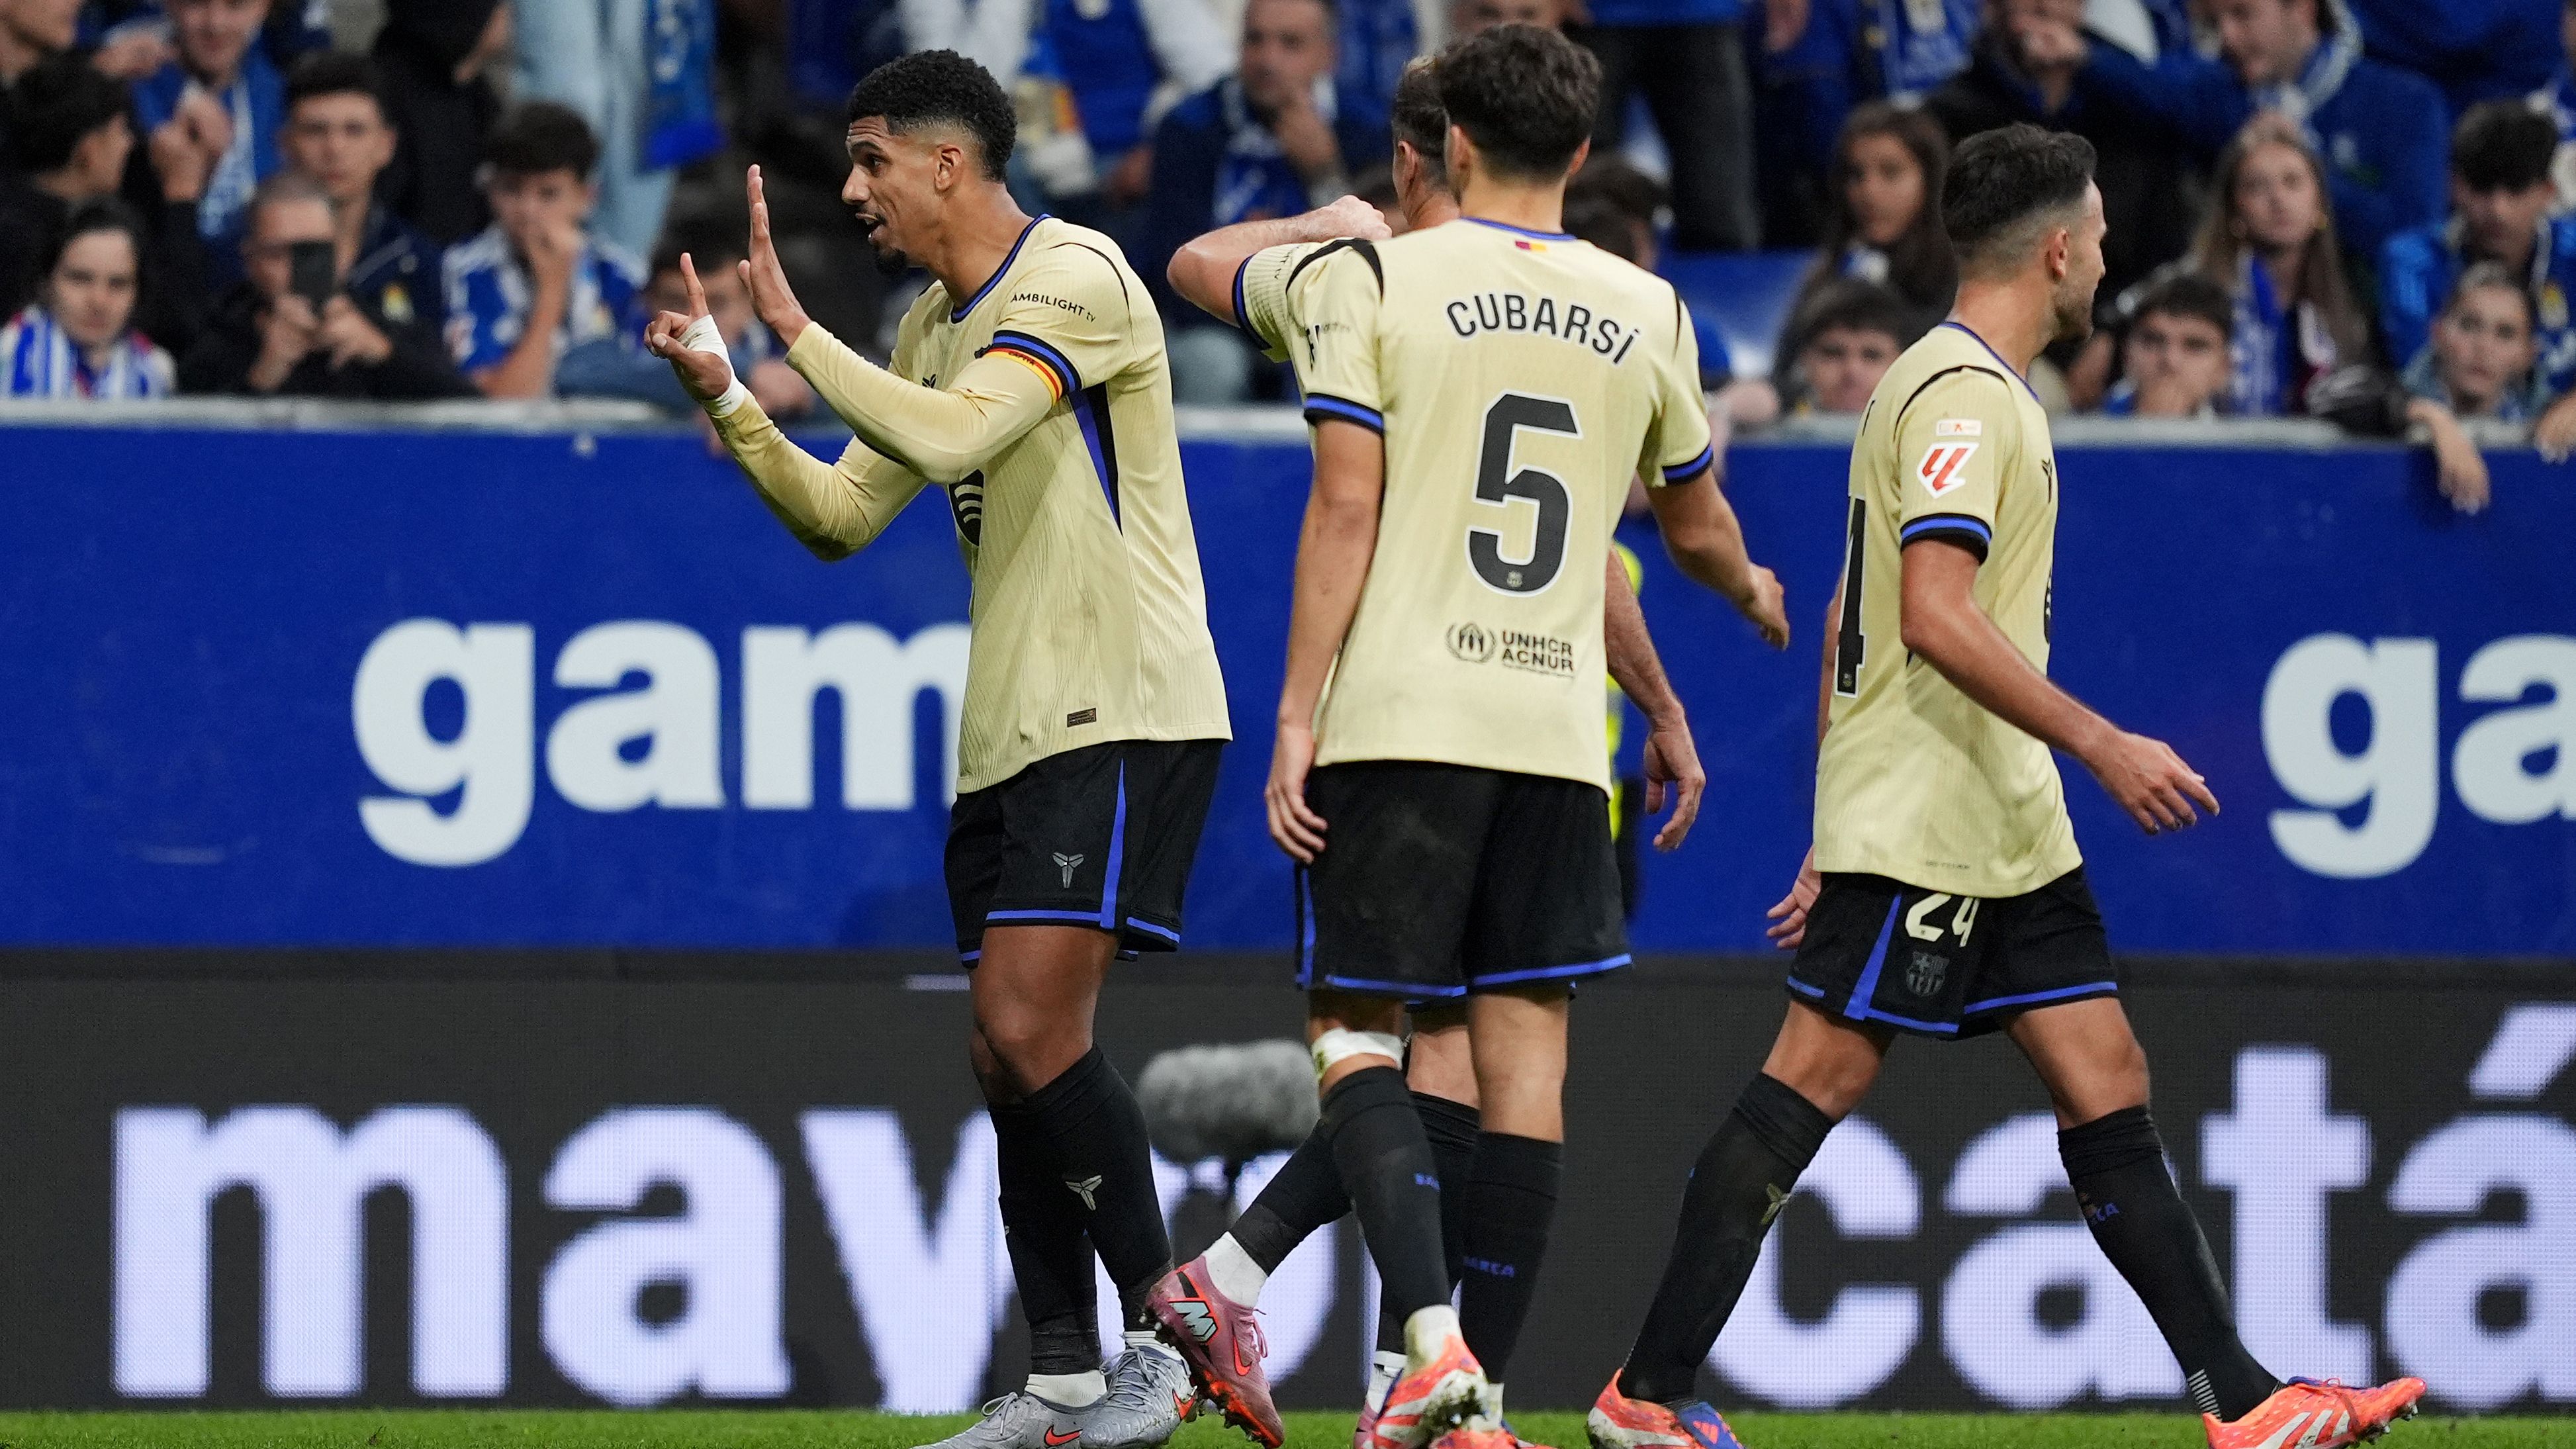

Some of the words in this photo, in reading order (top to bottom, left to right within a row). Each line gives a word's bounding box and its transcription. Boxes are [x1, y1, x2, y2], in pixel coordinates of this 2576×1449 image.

[1010, 293, 1085, 316] AMBILIGHT
[1467, 392, 1580, 594] 5
[1502, 630, 1572, 656] UNHCR
[1502, 648, 1574, 672] ACNUR
[2259, 631, 2576, 880] ga
[1905, 893, 1981, 948] 24
[111, 1103, 1461, 1415] mayo
[1706, 1003, 2576, 1411] catá
